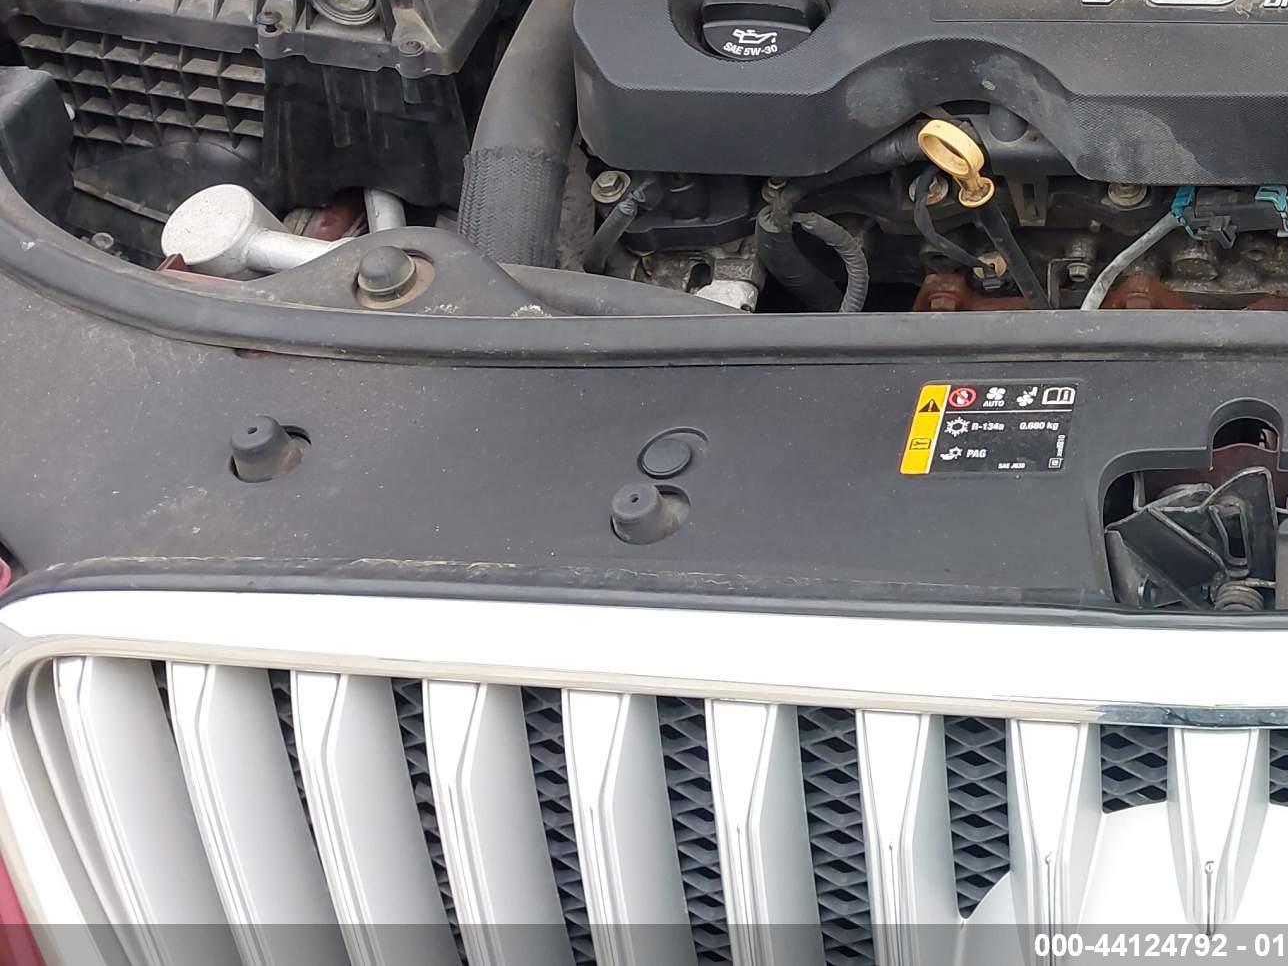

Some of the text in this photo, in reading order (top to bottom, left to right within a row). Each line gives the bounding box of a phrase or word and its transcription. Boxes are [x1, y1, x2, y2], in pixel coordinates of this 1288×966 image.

[723, 41, 778, 56] SAE 5W-30
[982, 400, 1005, 408] AUTO
[971, 421, 1005, 431] R-134a
[1046, 420, 1060, 431] kg
[965, 448, 987, 459] PAG
